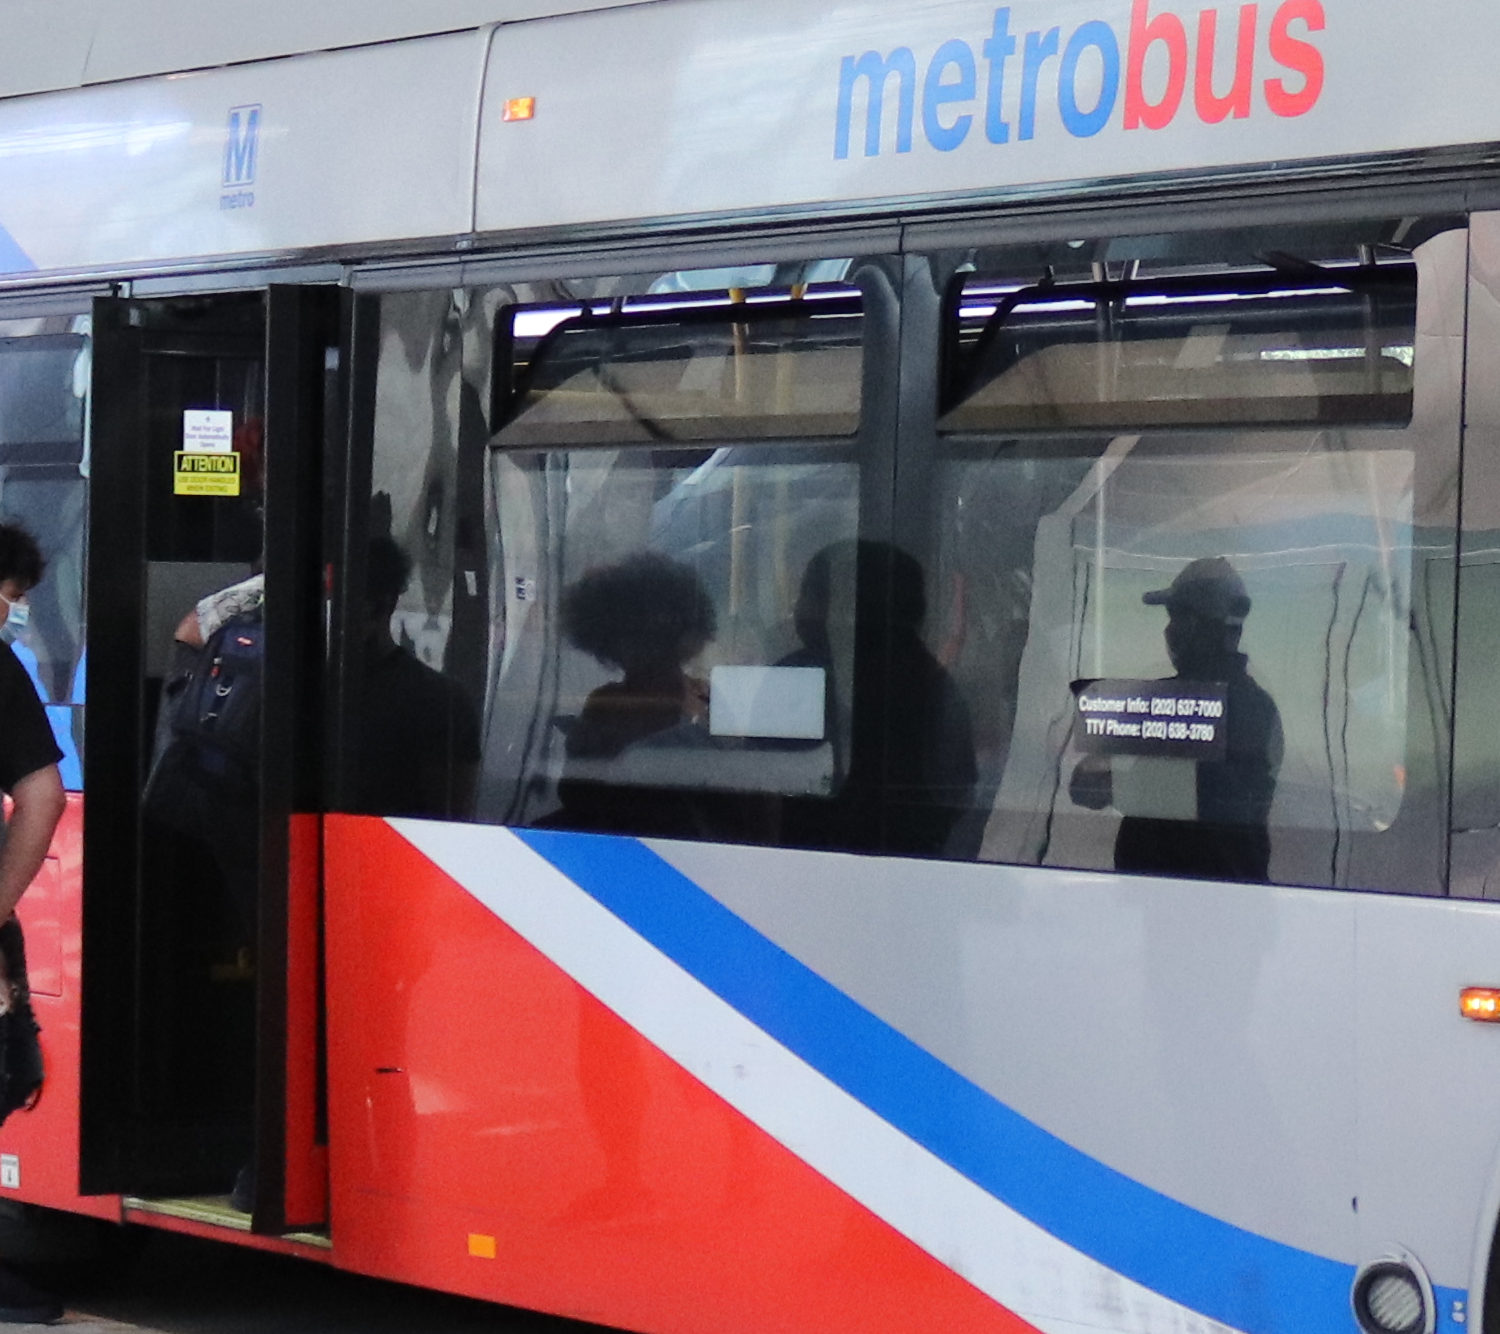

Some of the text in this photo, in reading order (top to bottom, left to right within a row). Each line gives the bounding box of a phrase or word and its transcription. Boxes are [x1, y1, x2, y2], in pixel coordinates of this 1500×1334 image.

[224, 109, 259, 182] M
[219, 190, 255, 211] metro
[180, 455, 235, 472] ATTENTION
[1079, 696, 1223, 718] Customer Info: (202) 637-7000
[1086, 718, 1106, 735] TTY
[1106, 720, 1141, 736] Phone:
[1142, 721, 1167, 739] (202)
